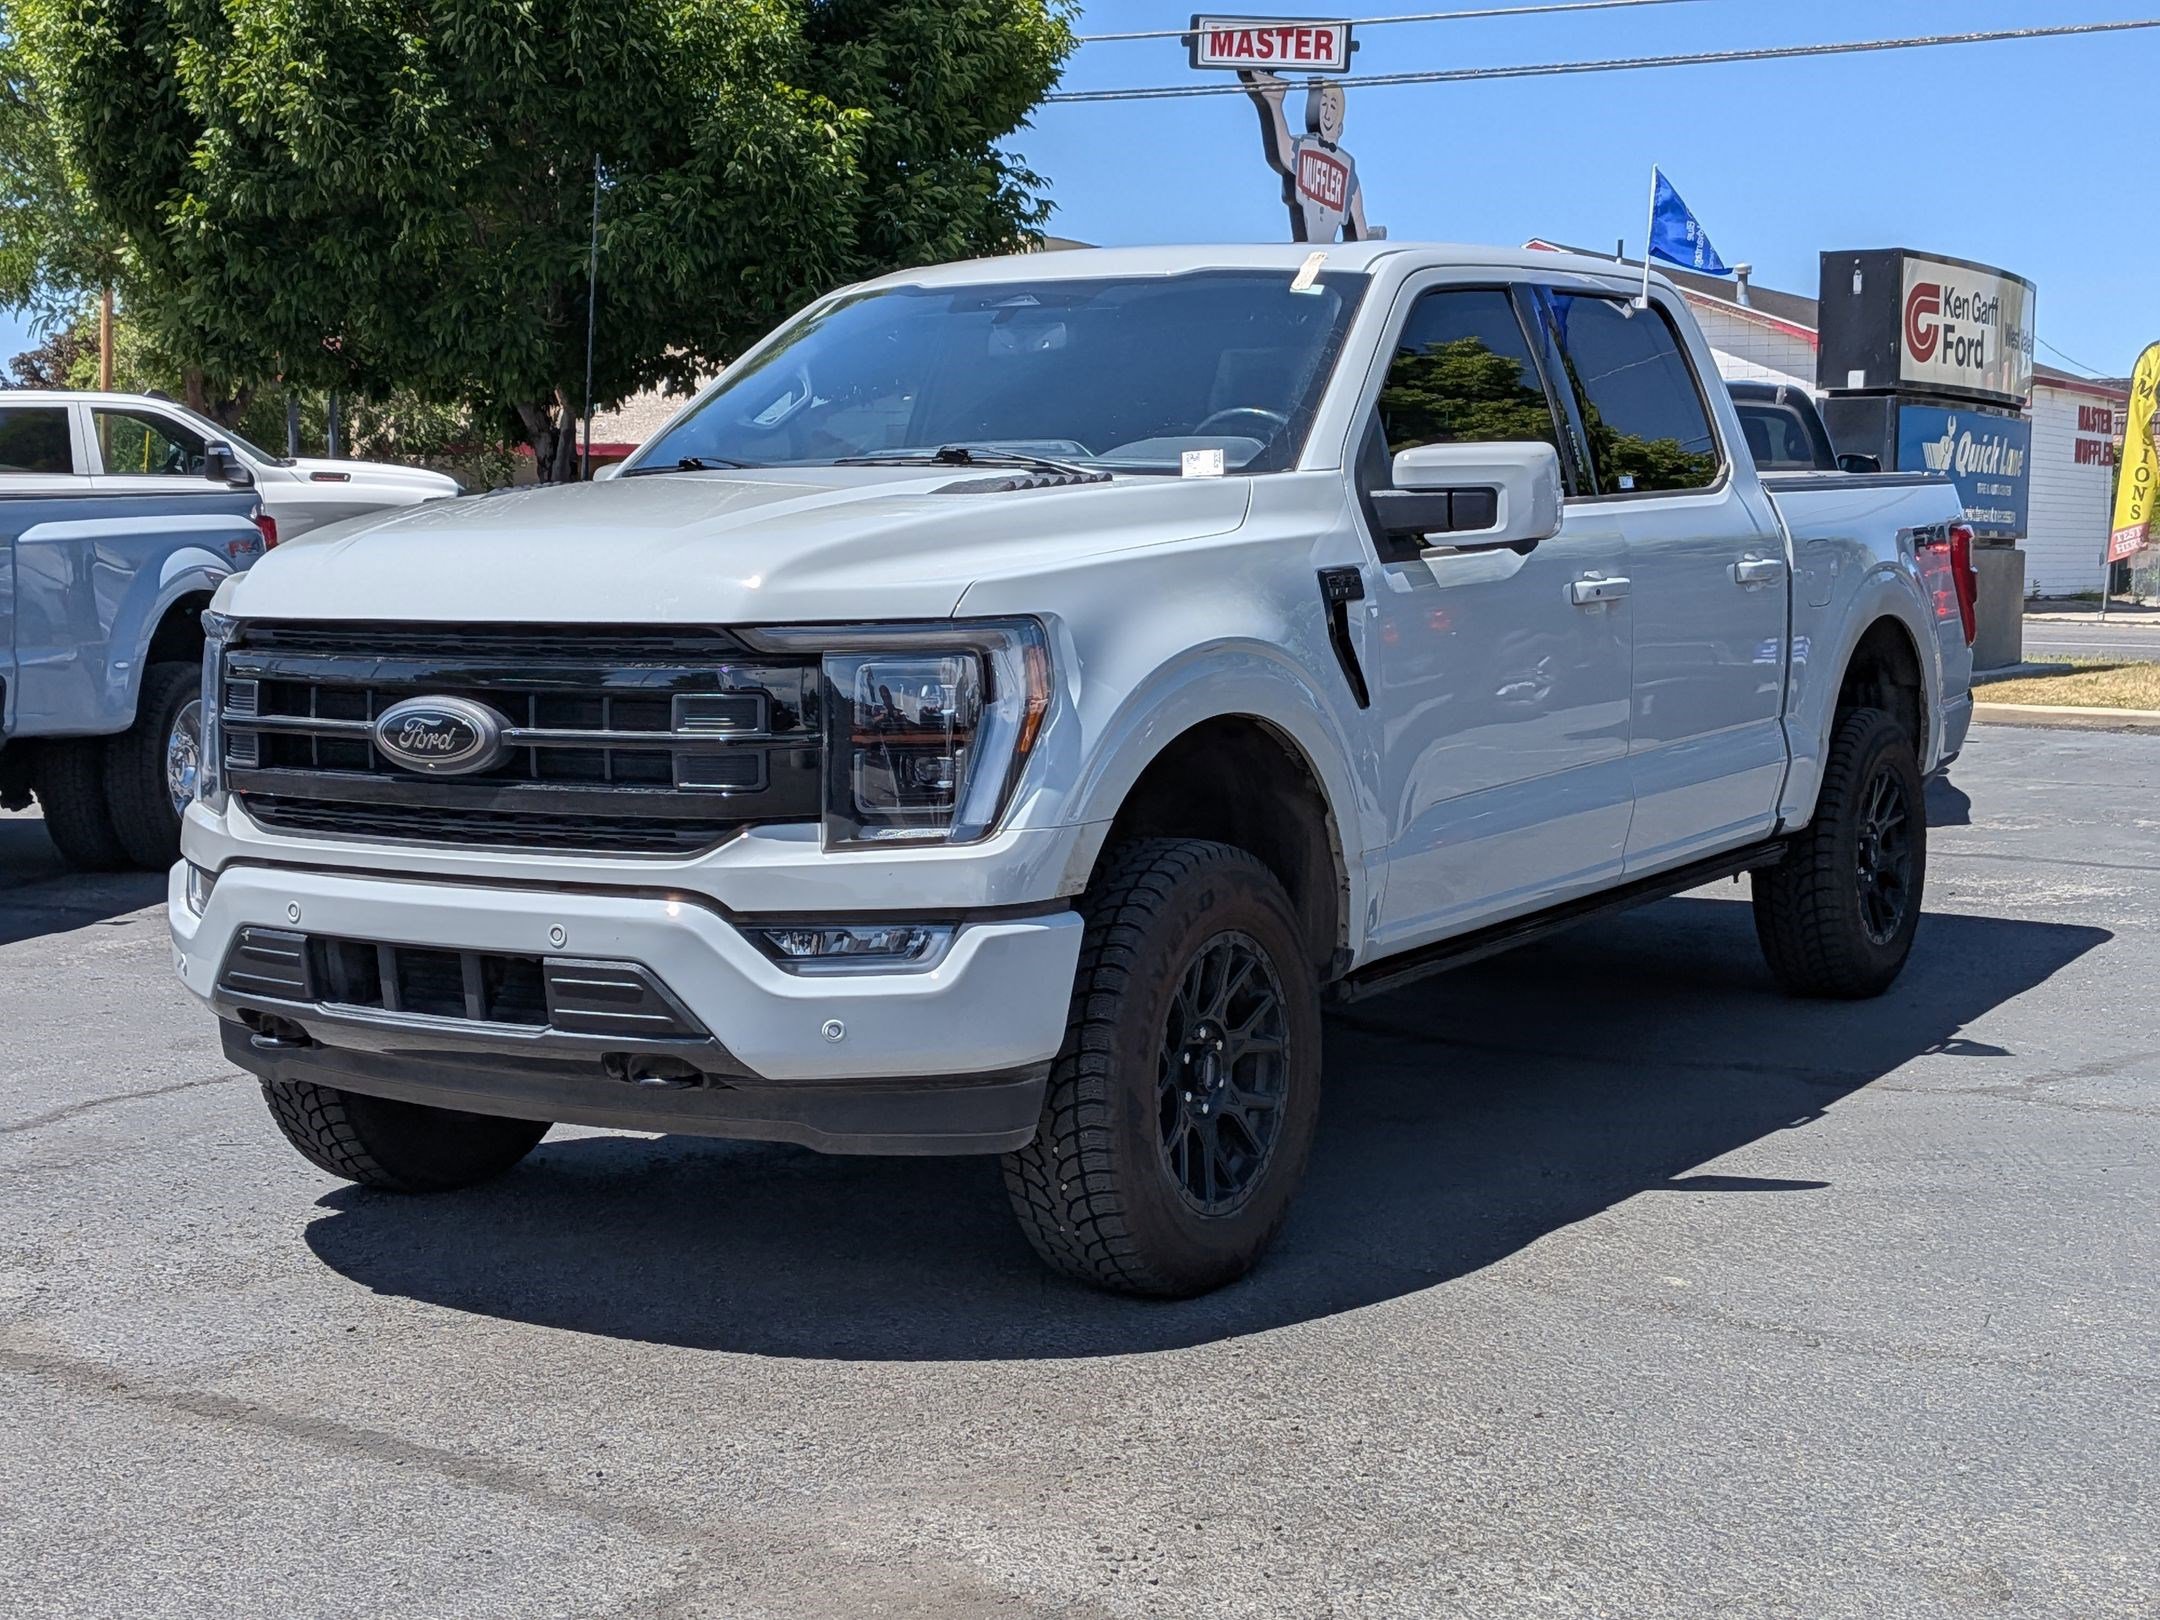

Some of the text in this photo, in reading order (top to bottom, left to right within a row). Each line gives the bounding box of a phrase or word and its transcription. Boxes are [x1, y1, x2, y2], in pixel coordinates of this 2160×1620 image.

[1210, 26, 1334, 61] MASTER
[1302, 154, 1344, 205] MUFFLER
[1943, 285, 1998, 327] Ken Garff
[1942, 324, 1985, 370] Ford
[2078, 405, 2112, 434] MASTER
[1955, 430, 2024, 478] Quick Lane
[398, 716, 457, 750] Ford
